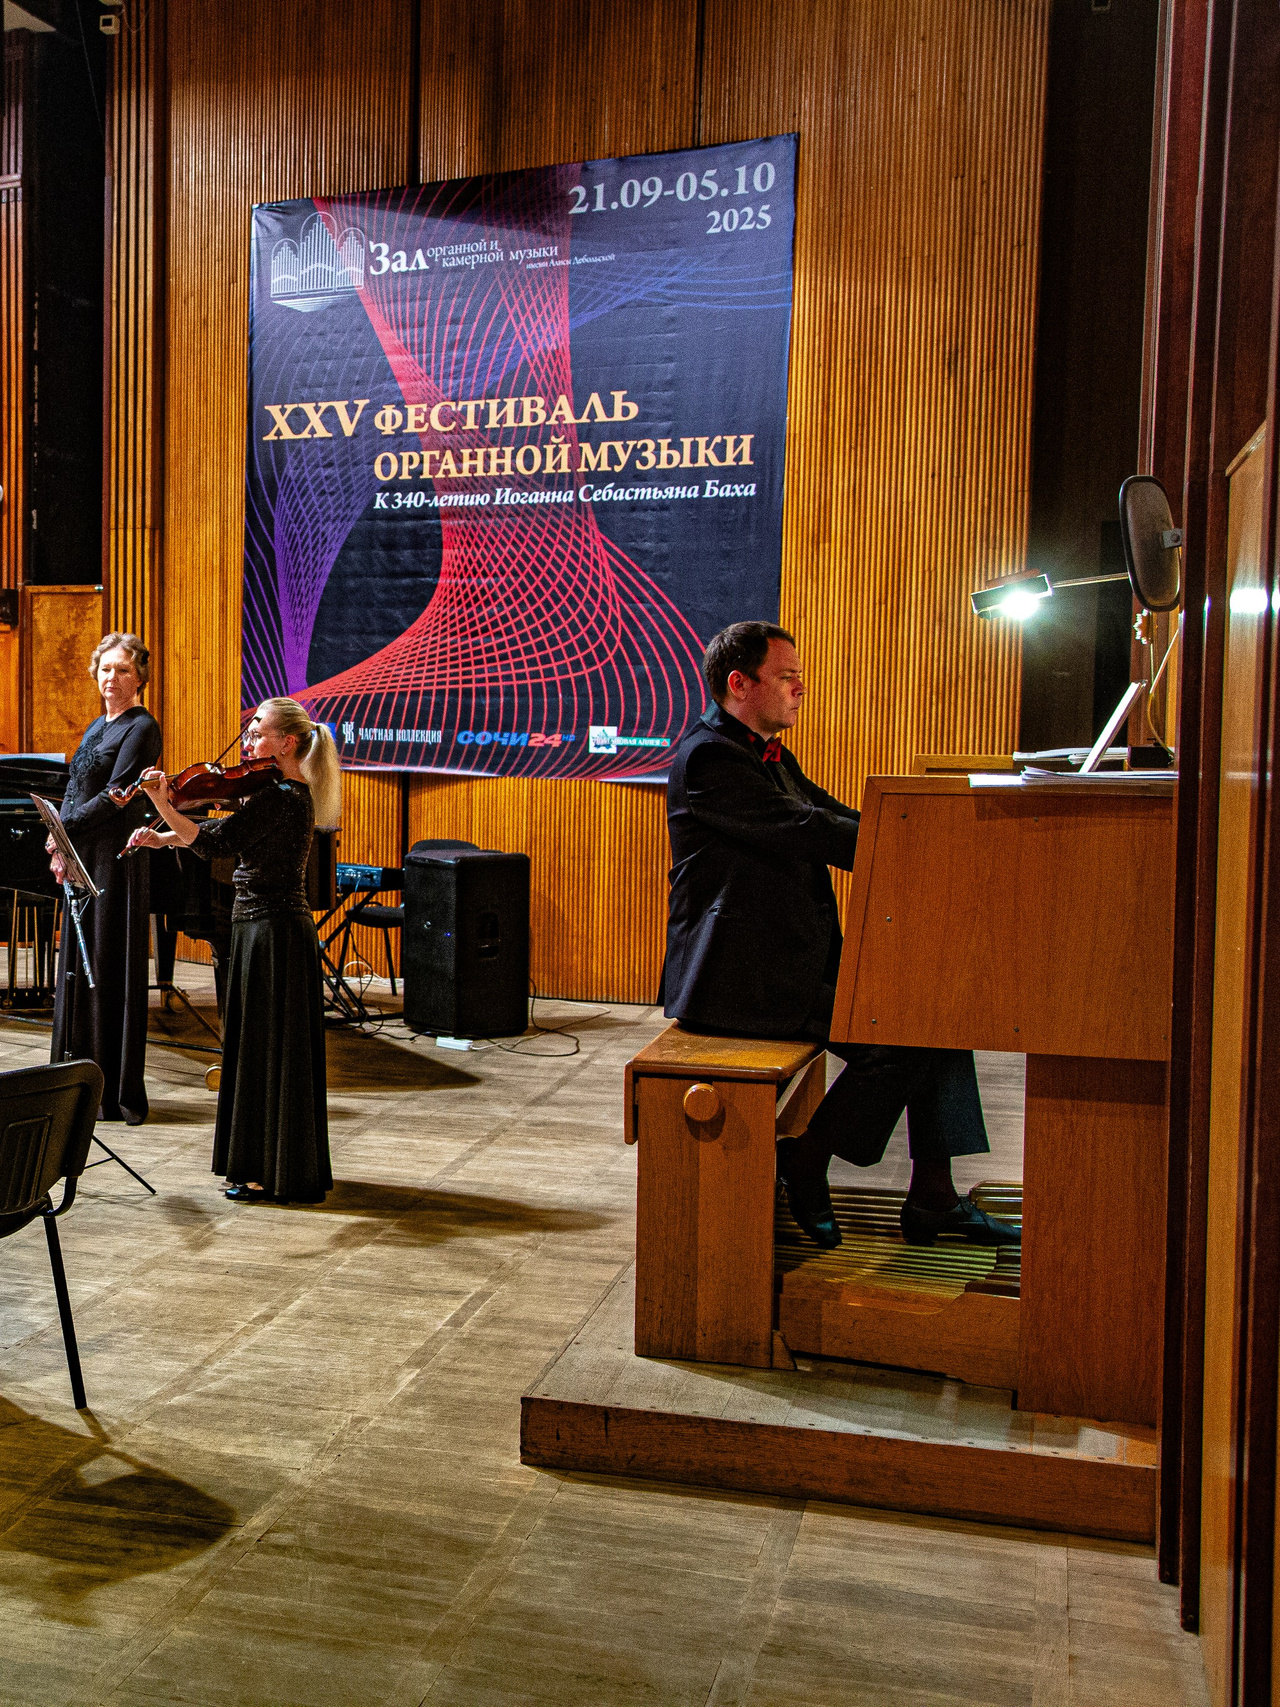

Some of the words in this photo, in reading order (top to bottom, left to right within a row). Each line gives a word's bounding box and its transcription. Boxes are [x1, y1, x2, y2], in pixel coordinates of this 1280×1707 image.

[569, 162, 776, 214] 21.09-05.10
[706, 204, 772, 234] 2025
[369, 241, 429, 275] Зал
[427, 238, 488, 261] органной
[490, 240, 498, 250] и
[442, 248, 504, 269] камерной
[509, 246, 558, 264] музыки
[262, 398, 370, 441] XXV
[373, 390, 639, 436] ФЕСТИВАЛЬ
[373, 434, 572, 482] ОРГАННОЙ
[577, 434, 755, 473] МУЗЫКИ
[373, 492, 390, 509] К
[394, 490, 491, 509] 340-летию
[493, 486, 574, 506] Иоганна
[578, 482, 700, 502] Себастьяна
[702, 479, 757, 498] Баха
[358, 727, 394, 741] ЧАСТНАЯ
[396, 729, 442, 744] КОЛЛЕКЦИЯ
